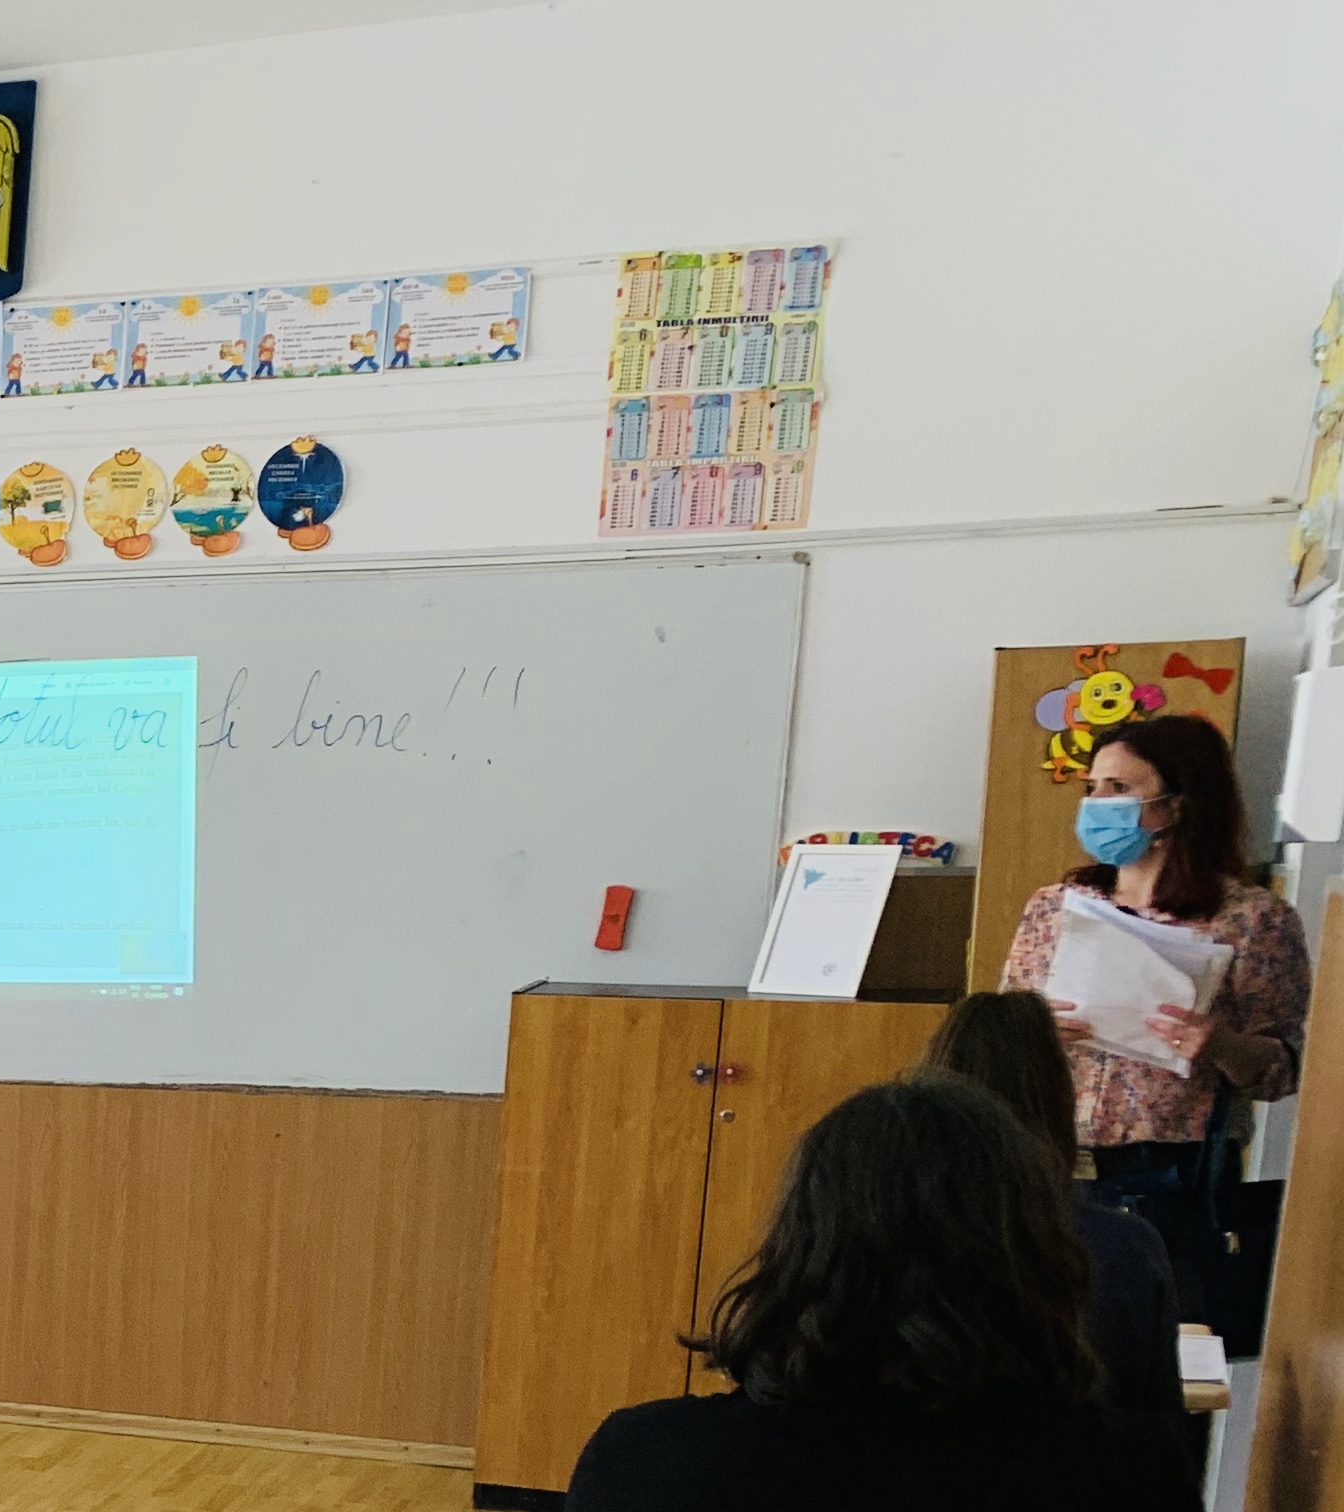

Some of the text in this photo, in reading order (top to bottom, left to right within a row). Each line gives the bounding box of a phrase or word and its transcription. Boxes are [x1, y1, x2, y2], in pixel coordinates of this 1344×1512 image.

[655, 318, 694, 328] TABLA
[108, 706, 168, 750] va
[198, 666, 249, 784] fi
